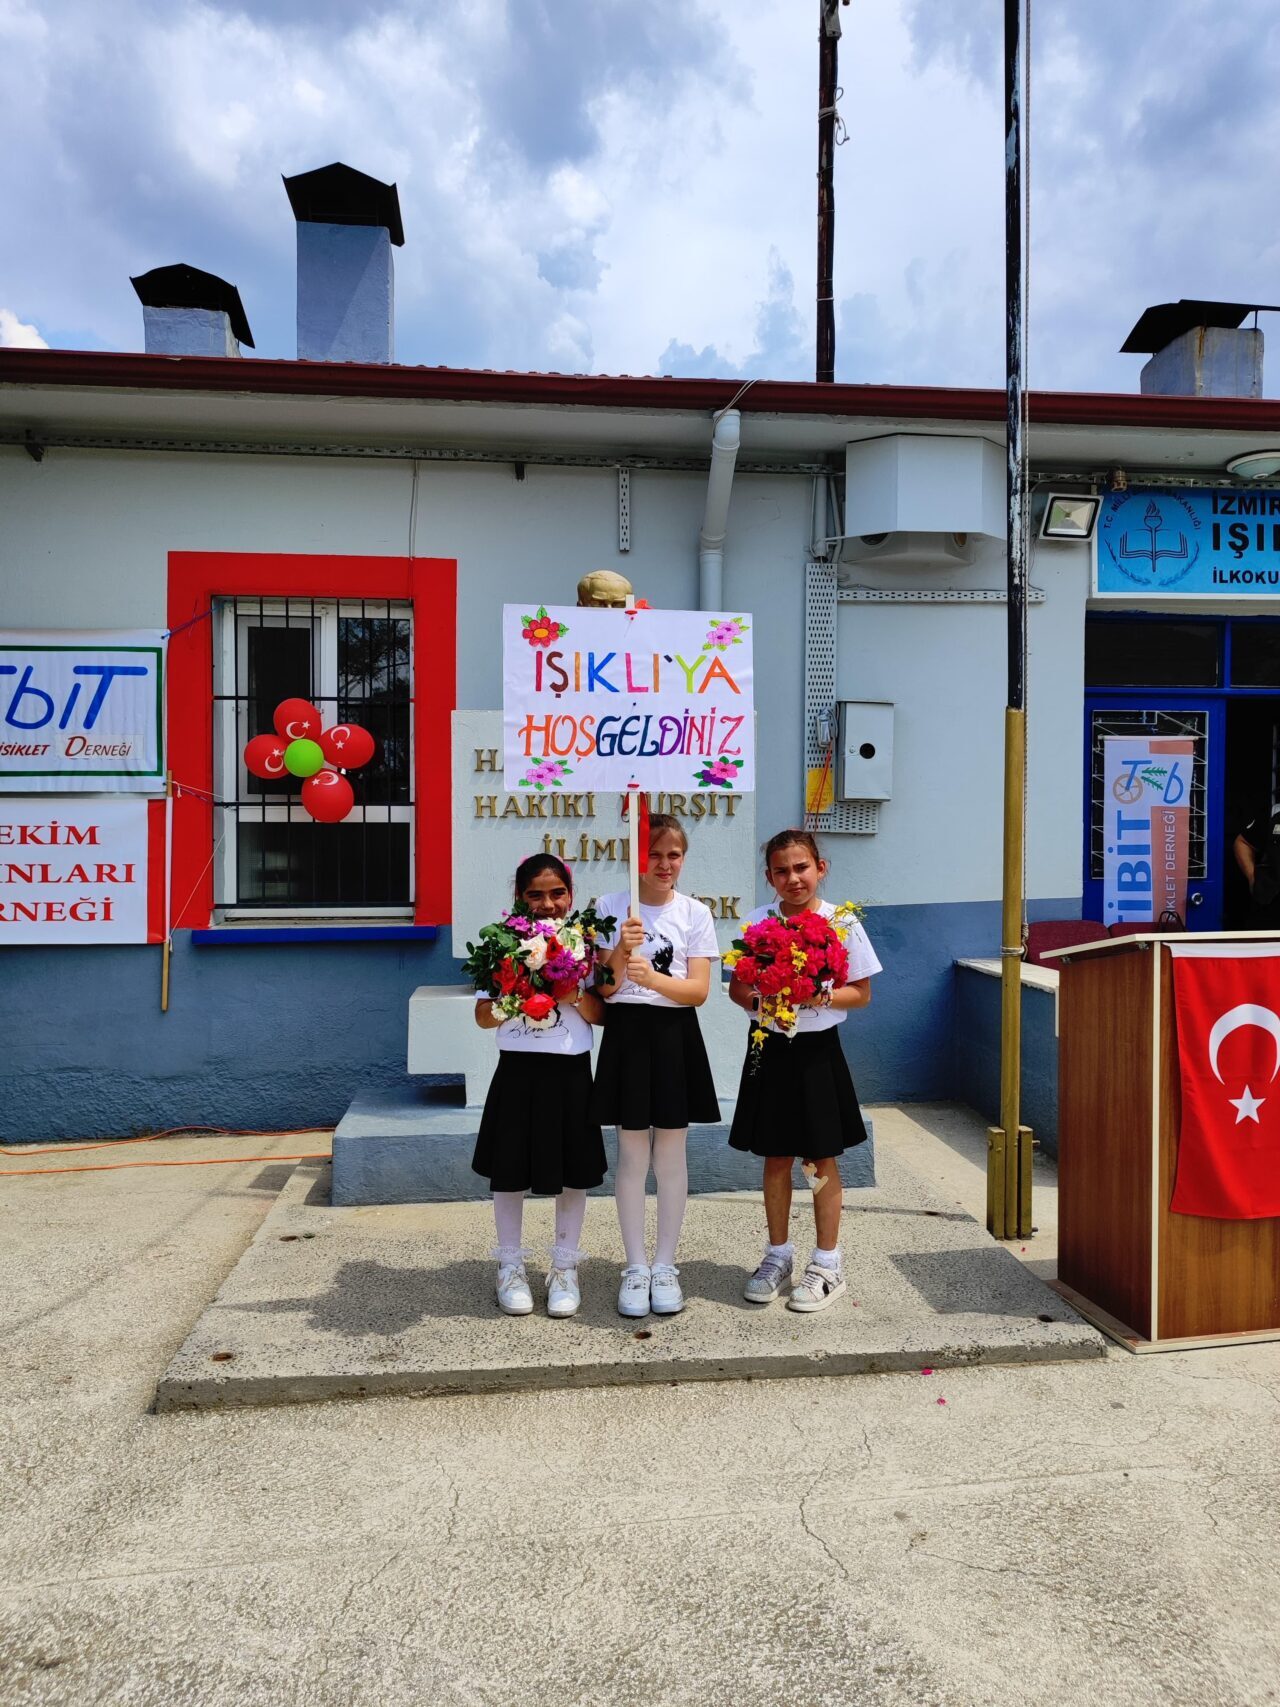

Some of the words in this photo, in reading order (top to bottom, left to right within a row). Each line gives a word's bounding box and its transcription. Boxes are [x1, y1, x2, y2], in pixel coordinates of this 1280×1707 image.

[1212, 567, 1280, 584] İLKOKU
[65, 735, 133, 757] DERNEĞİ
[474, 792, 596, 819] HAKİKİ
[542, 832, 630, 862] İLİM
[1162, 810, 1177, 870] DERNEĞİ
[0, 863, 137, 884] NLARI
[1107, 810, 1153, 923] İBİT
